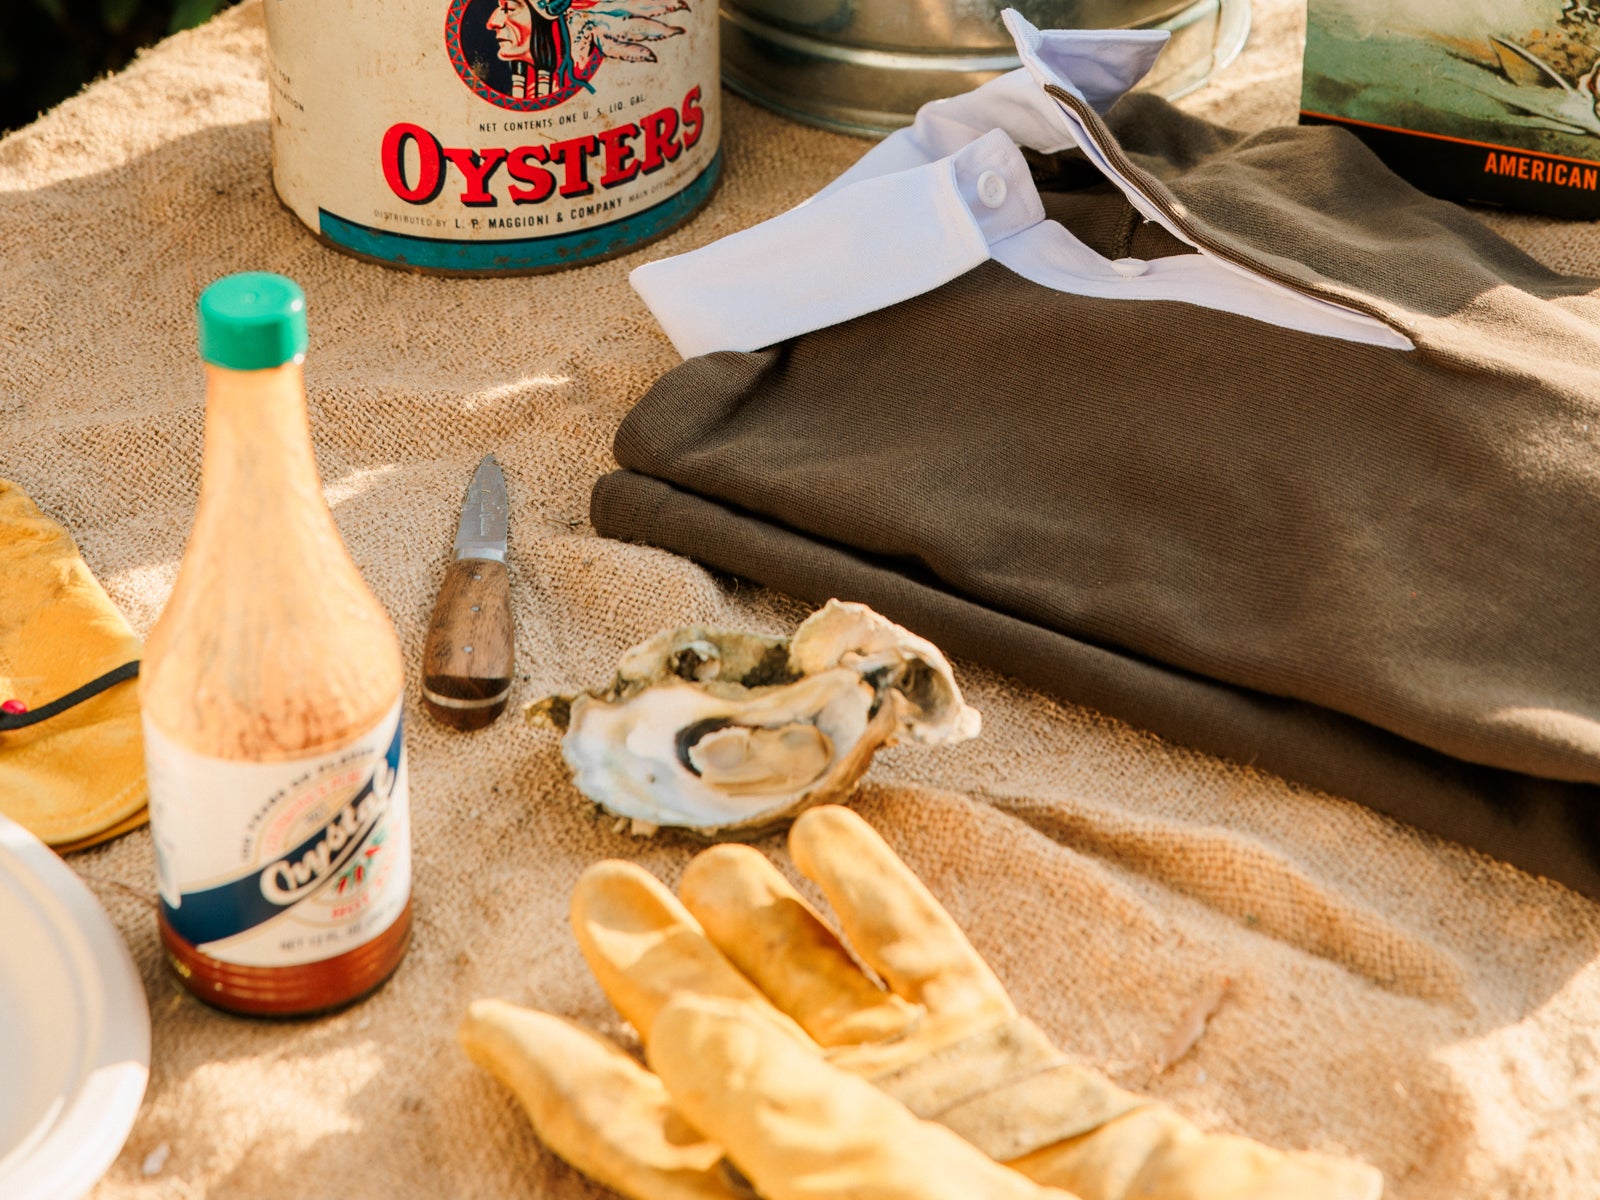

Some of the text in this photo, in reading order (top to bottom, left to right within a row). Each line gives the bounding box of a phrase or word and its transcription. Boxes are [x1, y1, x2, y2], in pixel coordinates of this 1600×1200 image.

[479, 122, 497, 133] NET
[503, 118, 554, 132] CONTENTS
[558, 113, 578, 125] ONE
[381, 85, 705, 208] OYSTERS
[1484, 152, 1599, 192] AMERICAN
[373, 209, 433, 227] DISTRIBUTED
[435, 218, 448, 228] BY
[455, 218, 465, 229] L.
[488, 214, 549, 230] MAGGIONI
[556, 212, 564, 223] &
[570, 196, 623, 220] COMPANY
